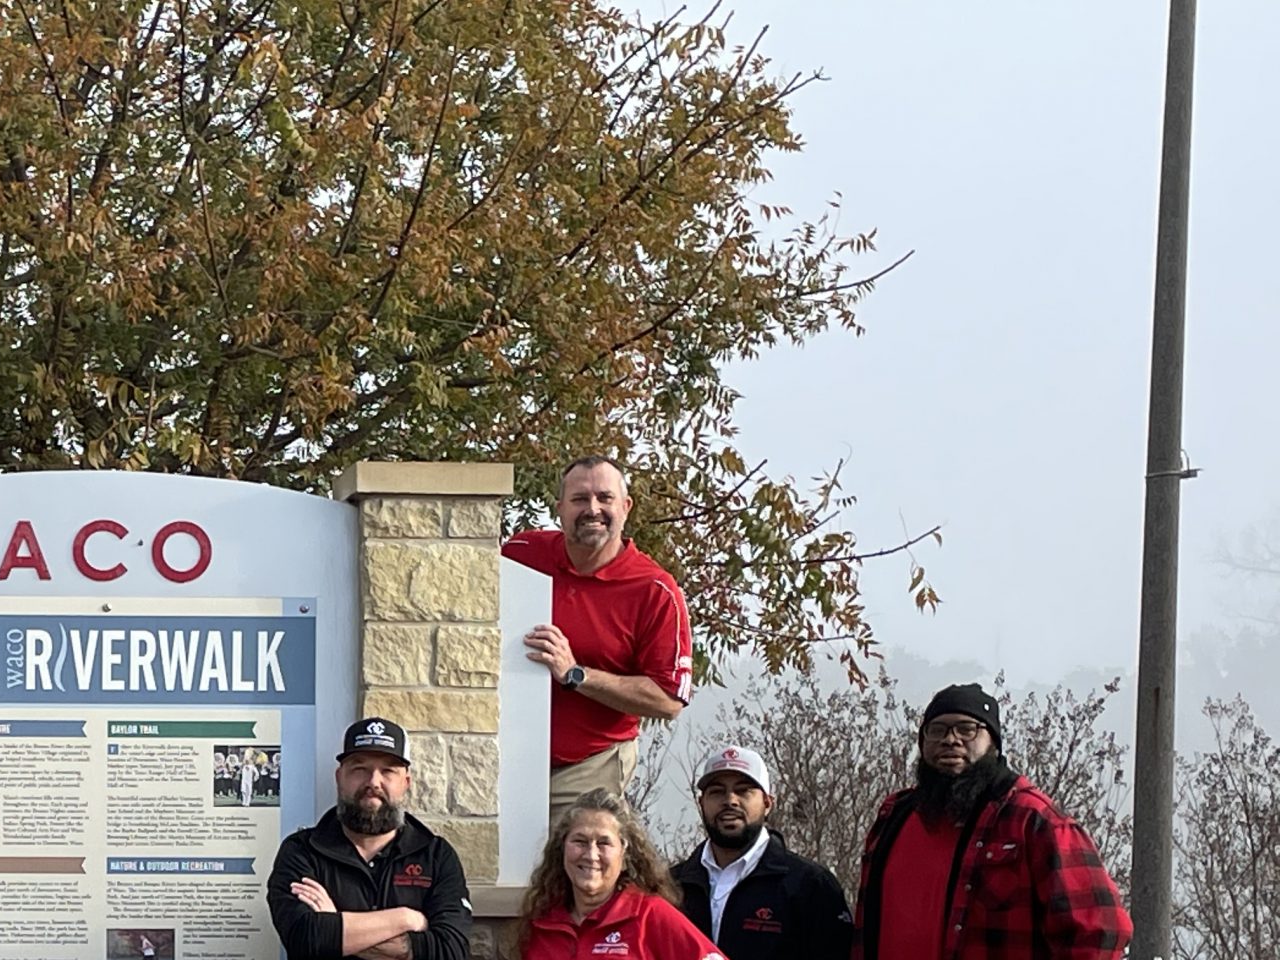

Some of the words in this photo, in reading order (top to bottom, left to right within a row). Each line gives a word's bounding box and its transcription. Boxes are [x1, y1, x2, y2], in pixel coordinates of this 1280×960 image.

[6, 628, 24, 689] waco
[25, 623, 286, 692] RIVERWALK
[110, 724, 138, 734] BAYLOR
[139, 725, 159, 734] TRAIL
[110, 861, 137, 871] NATURE
[146, 861, 179, 871] OUTDOOR
[181, 862, 225, 871] RECREATION
